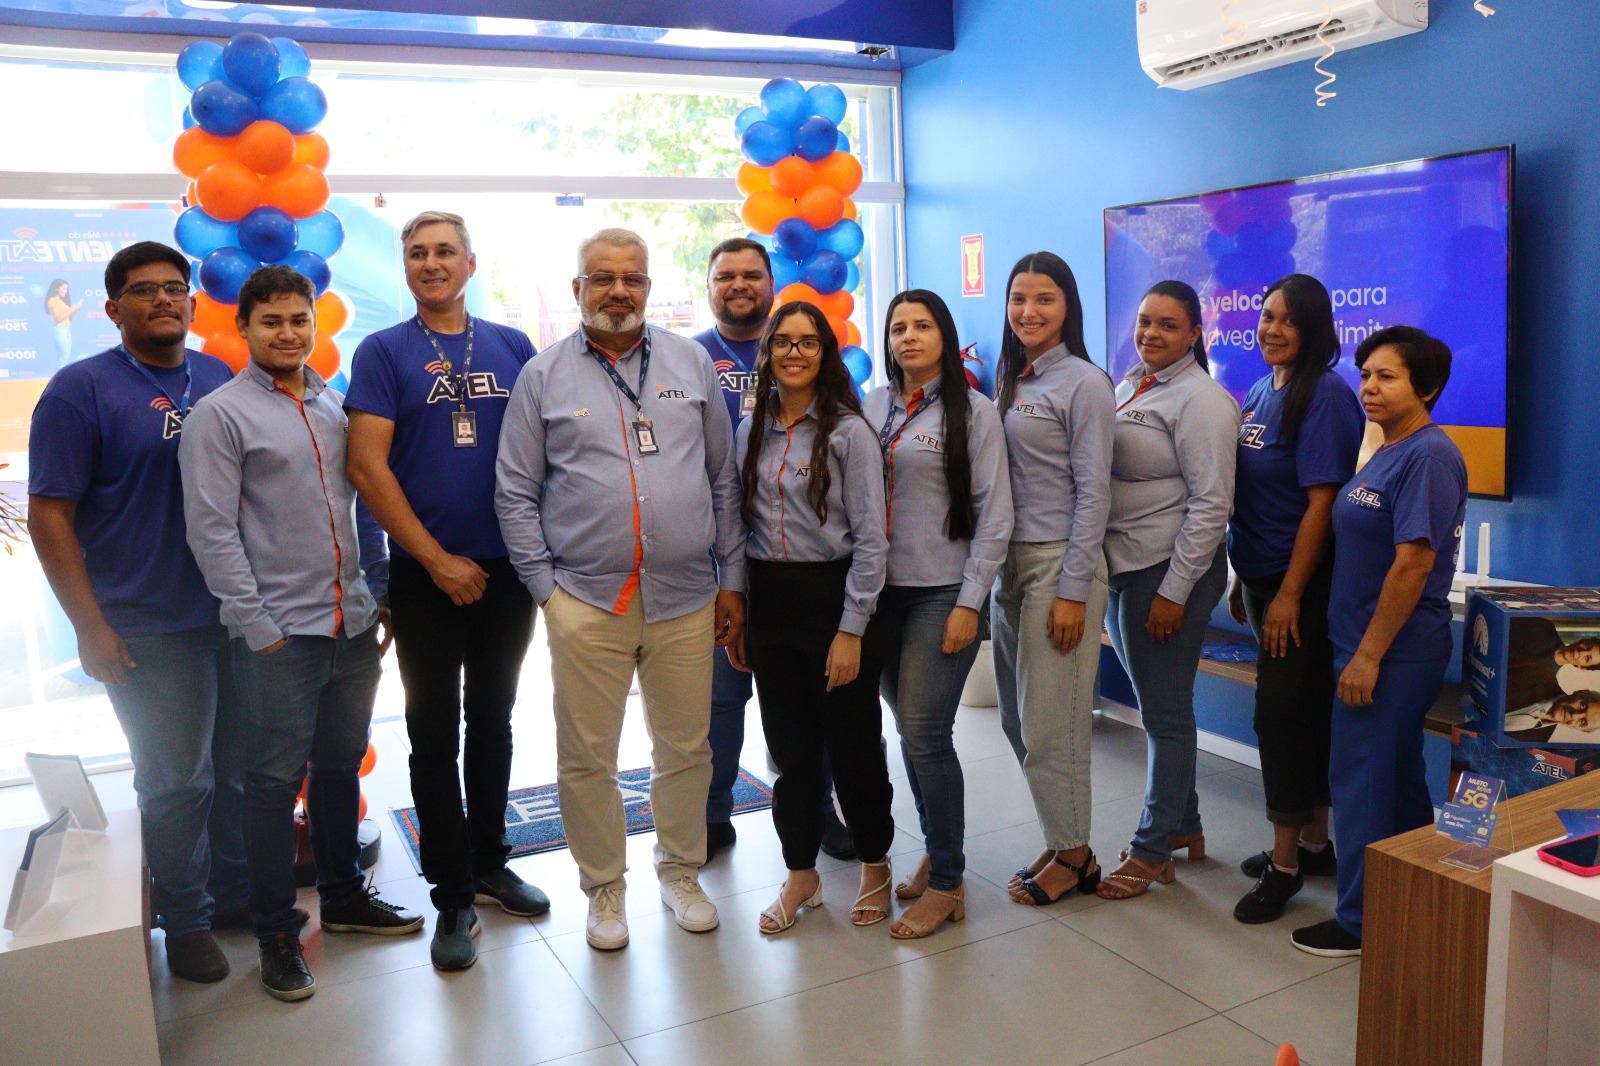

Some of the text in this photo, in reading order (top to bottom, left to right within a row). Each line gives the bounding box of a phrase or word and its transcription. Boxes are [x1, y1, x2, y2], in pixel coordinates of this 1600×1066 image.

[1331, 286, 1387, 312] para
[658, 389, 689, 400] ATEL
[1013, 404, 1037, 416] ATEL
[1122, 409, 1146, 424] ATEL
[911, 434, 941, 451] ATEL
[1237, 423, 1267, 449] TEL
[1347, 487, 1381, 507] ATEL
[1532, 761, 1568, 780] ATEL
[1468, 777, 1489, 788] MUITO
[1476, 785, 1492, 794] MAIS
[1459, 788, 1489, 809] 5G
